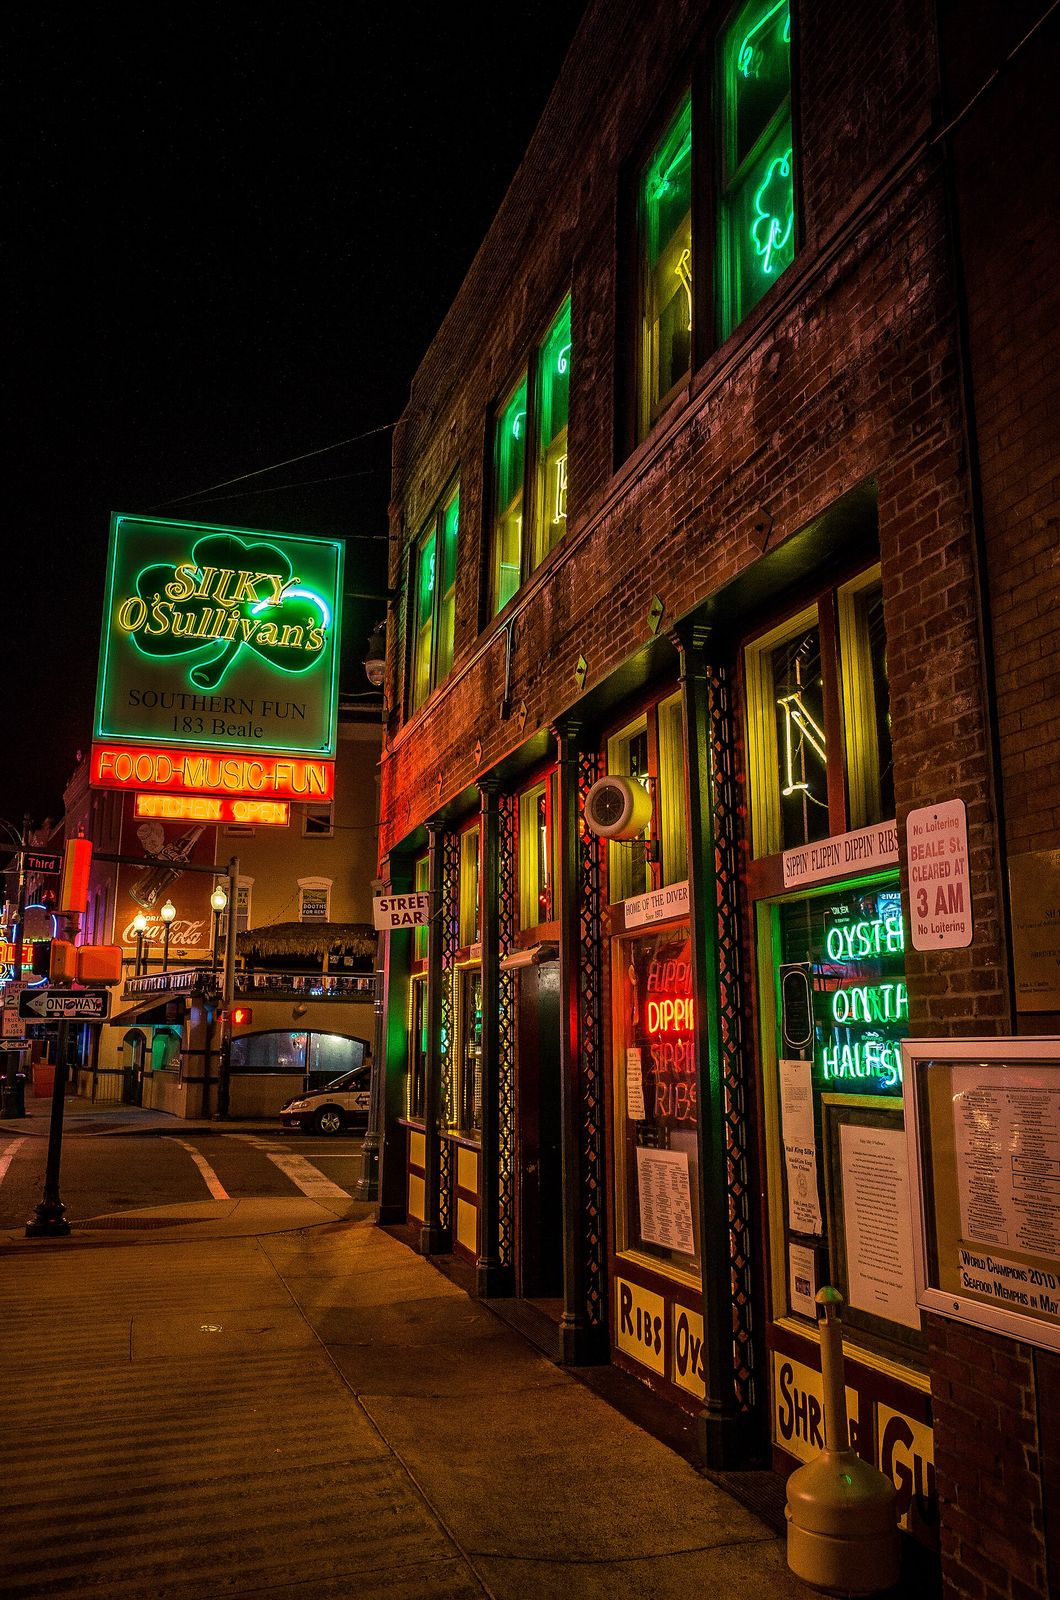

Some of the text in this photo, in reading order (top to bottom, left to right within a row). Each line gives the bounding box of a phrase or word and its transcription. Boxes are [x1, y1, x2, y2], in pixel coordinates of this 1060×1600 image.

[165, 564, 301, 608] SILKY
[118, 593, 325, 651] O'Sullivan's
[128, 689, 307, 720] SOUTHERN FUN
[172, 716, 263, 739] 183 Beale
[138, 797, 288, 820] KITCHEN OPEN
[913, 818, 959, 835] No Loitering
[844, 834, 875, 862] DIPPIN'
[878, 828, 899, 855] RIBS
[911, 837, 963, 861] BEALE St.
[28, 858, 55, 870] Third
[912, 858, 964, 882] CLEARED AT
[380, 896, 429, 911] STREET
[625, 901, 641, 916] HOME
[642, 898, 650, 911] OF
[651, 894, 665, 907] THE
[916, 882, 964, 918] 3 AM
[391, 912, 424, 926] BAR
[918, 921, 965, 934] No Loitering
[74, 998, 98, 1010] WAY
[879, 984, 908, 1019] TH
[823, 1042, 880, 1079] HALF
[961, 1250, 986, 1270] WORLD
[987, 1257, 1028, 1282] CHAMPIONS
[1028, 1269, 1056, 1289] 2010
[963, 1272, 1058, 1314] SEAFOOD MEMPHIS IN MAY
[620, 1283, 662, 1356] RIBS
